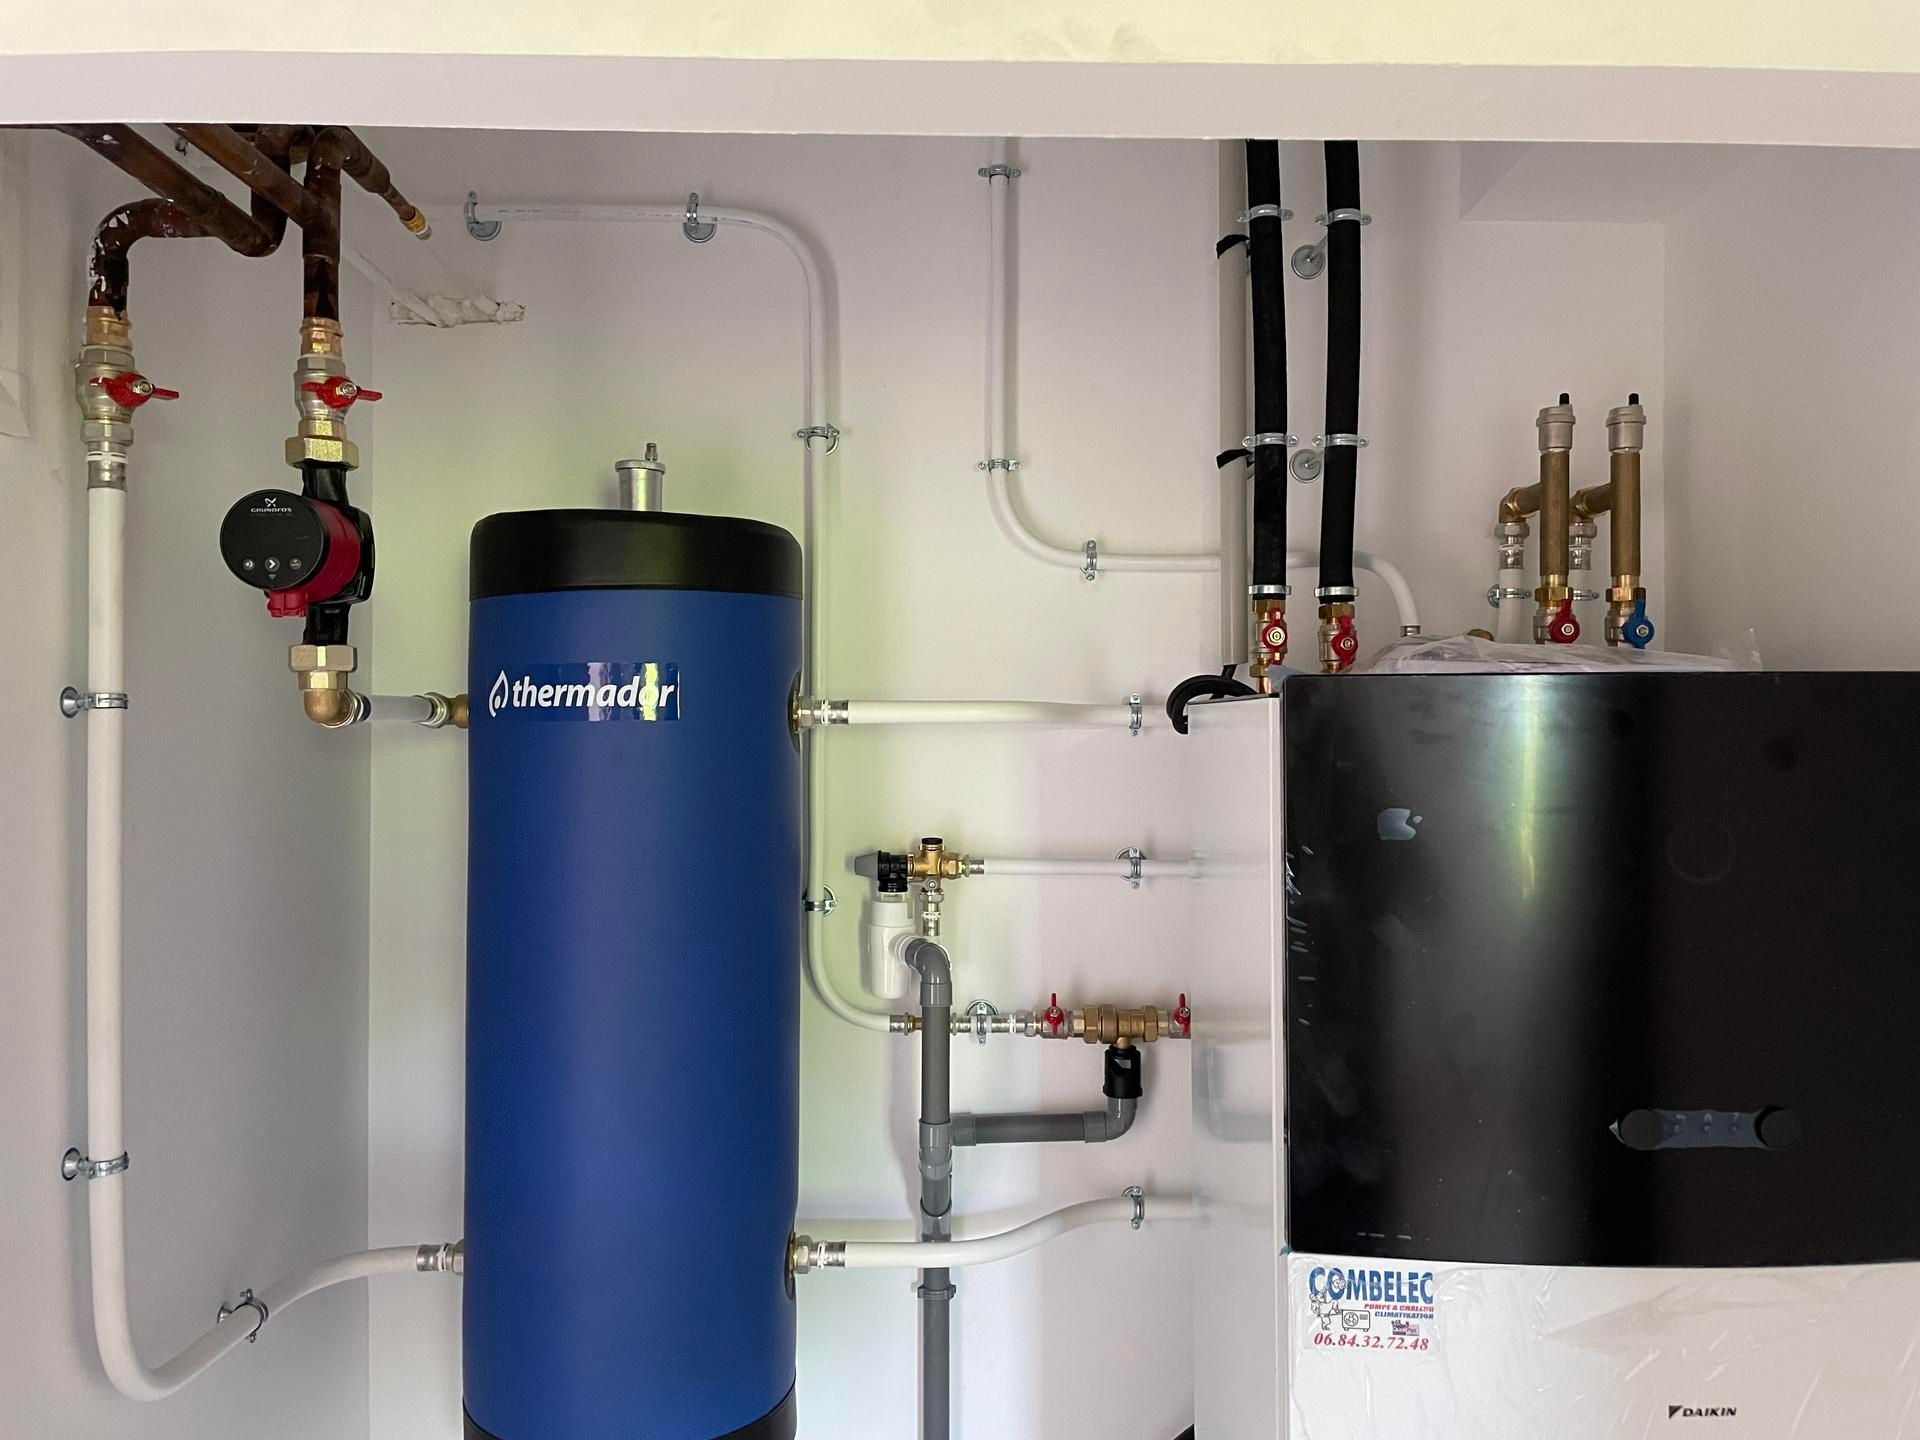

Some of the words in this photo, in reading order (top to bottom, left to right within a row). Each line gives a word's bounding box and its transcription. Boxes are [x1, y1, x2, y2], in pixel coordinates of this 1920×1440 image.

[512, 675, 675, 708] thermador
[1308, 1267, 1434, 1304] COMBELEC
[1374, 1311, 1434, 1319] CLIMATISATION
[1313, 1332, 1429, 1351] 06.84.32.72.48
[1682, 1407, 1737, 1417] DAIKIN
